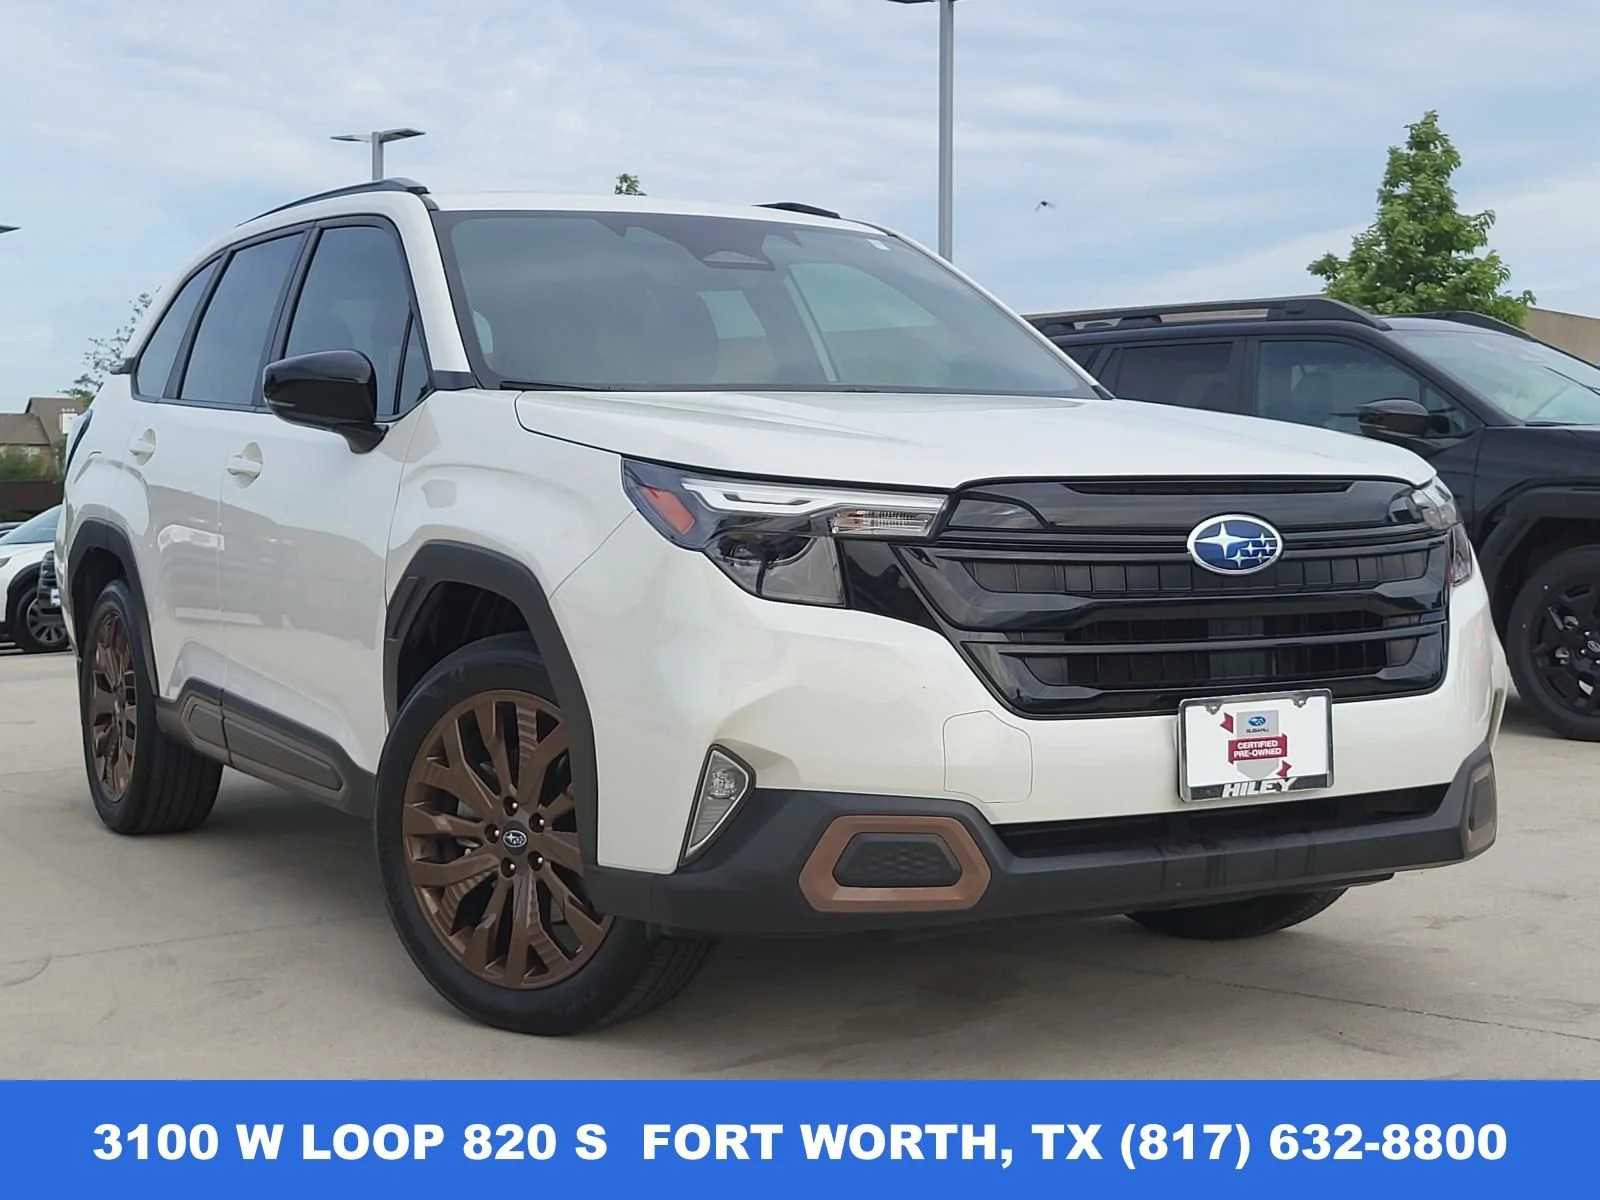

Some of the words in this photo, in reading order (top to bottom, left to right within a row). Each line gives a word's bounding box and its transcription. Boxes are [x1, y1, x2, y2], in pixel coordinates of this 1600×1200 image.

[1237, 740, 1279, 750] CERTIFIED
[1233, 748, 1282, 758] PRE-OWNED
[1222, 777, 1297, 798] HILEY
